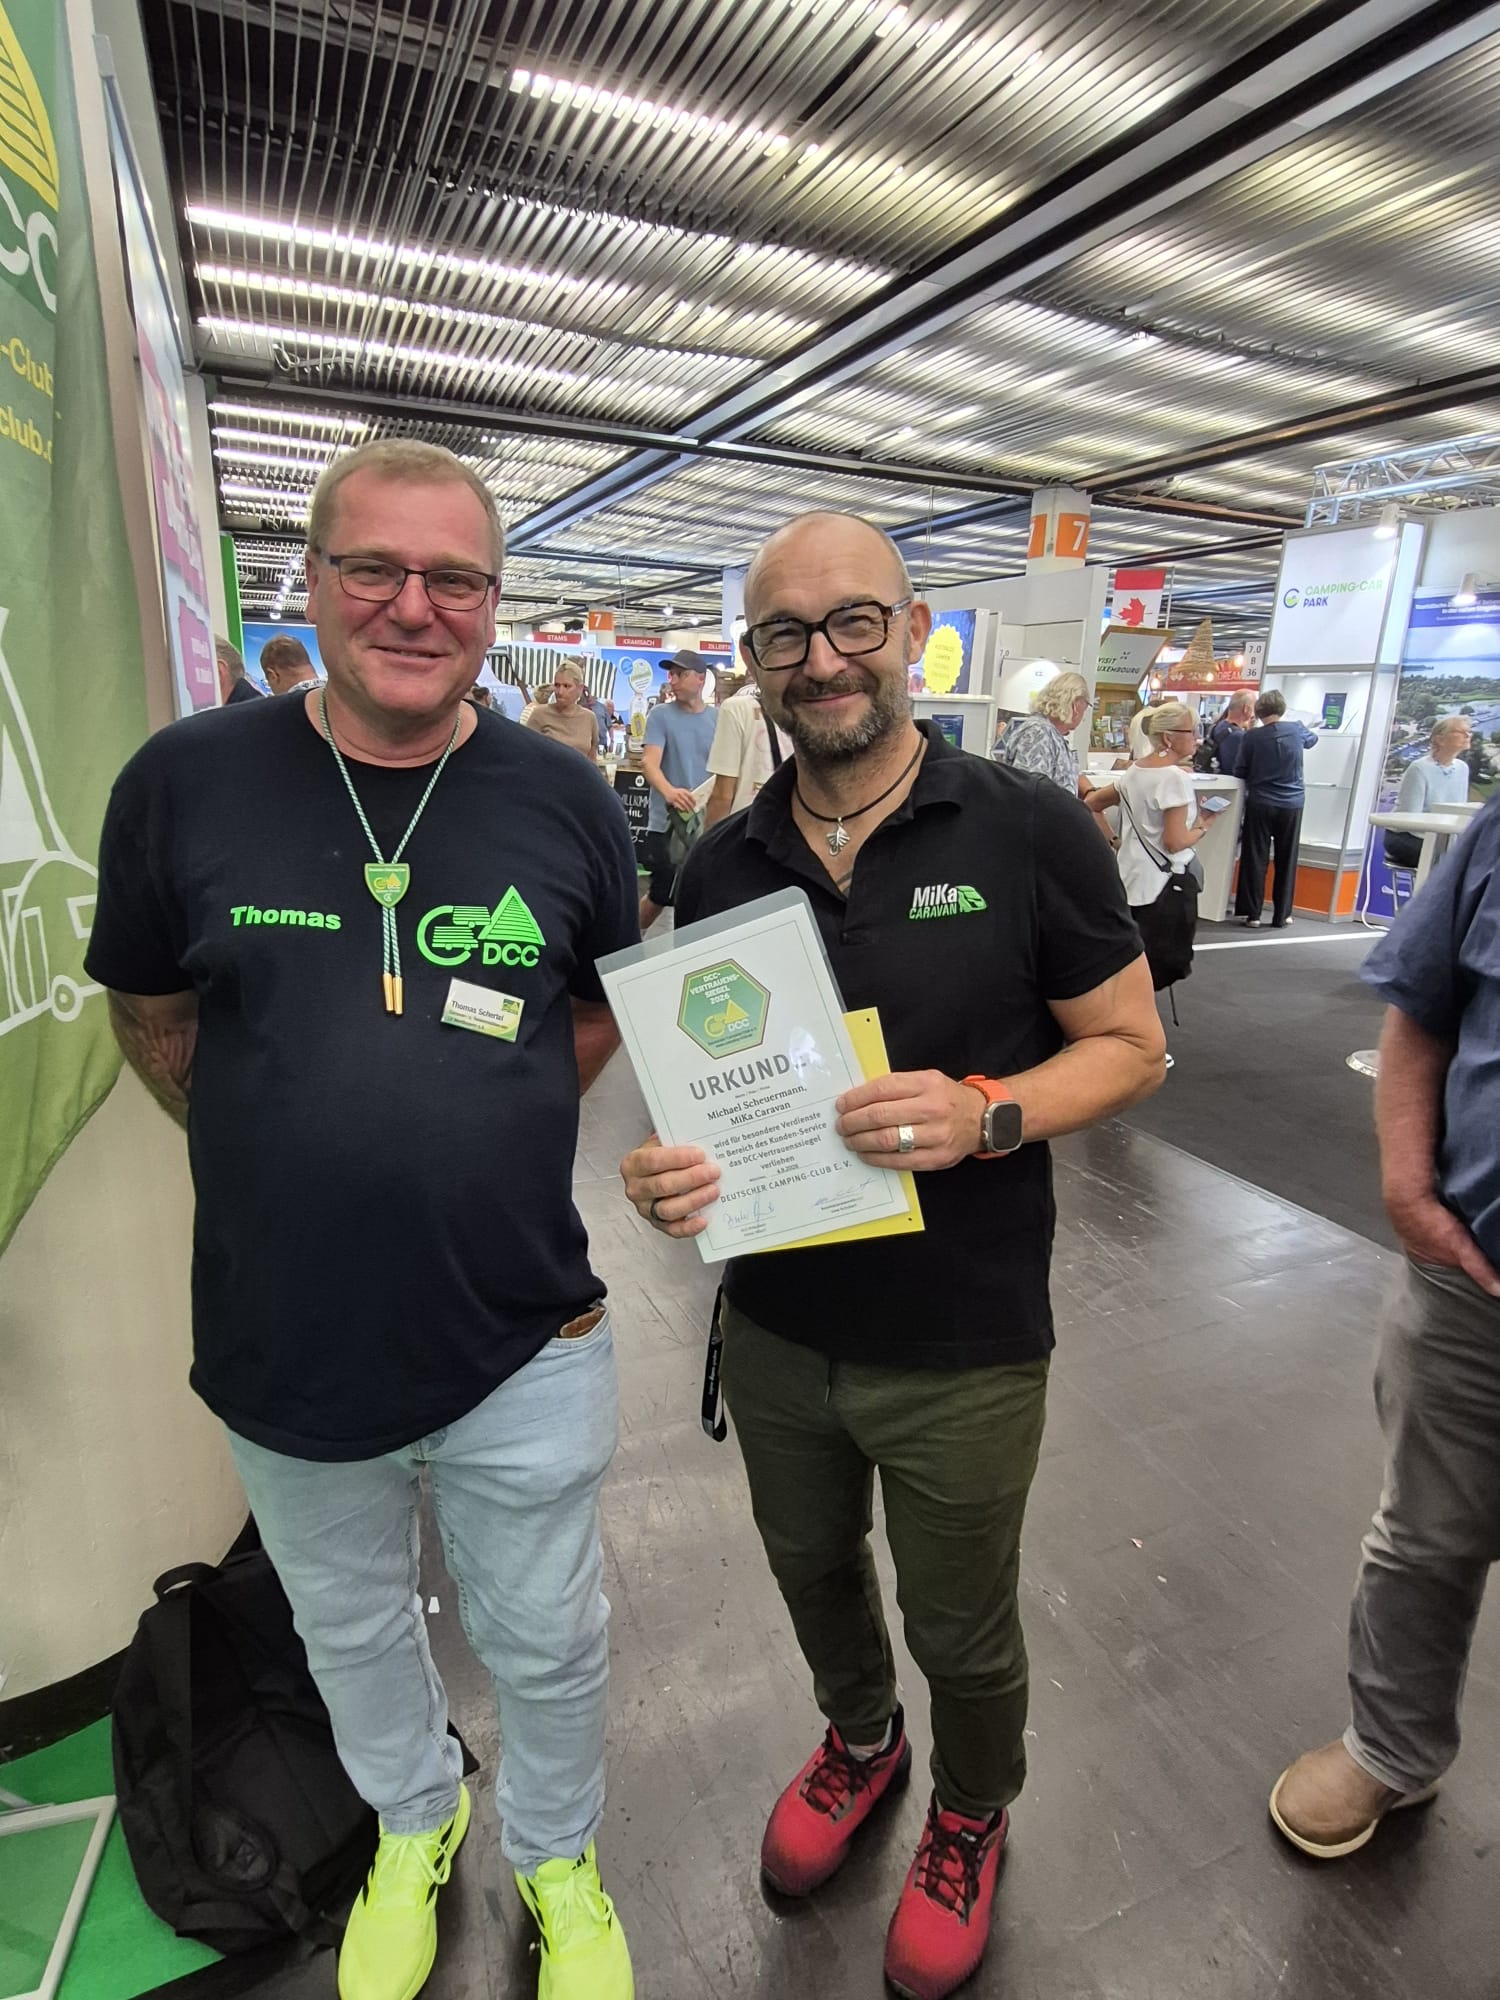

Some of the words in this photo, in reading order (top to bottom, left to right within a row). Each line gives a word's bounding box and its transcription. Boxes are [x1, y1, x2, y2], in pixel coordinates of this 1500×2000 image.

[1072, 520, 1086, 552] 7
[1305, 580, 1383, 596] CAMPING-CAR
[1303, 597, 1329, 608] PARK
[593, 613, 602, 628] 7
[1248, 645, 1262, 654] 7.0
[1098, 656, 1117, 664] VISIT
[1096, 665, 1141, 674] UXEMBOURG
[1247, 669, 1257, 677] 36
[912, 883, 958, 908] MiKa
[230, 905, 342, 930] Thomas
[909, 902, 957, 920] CARAVAN
[481, 942, 541, 967] DCC
[690, 973, 740, 996] VERTRAUENS-
[703, 972, 721, 983] DCC-
[704, 985, 731, 999] SIEGEL
[451, 1000, 477, 1014] Thomas
[727, 1019, 750, 1033] DCC
[689, 1054, 807, 1101] URKUND
[707, 1103, 742, 1121] Michael
[730, 1112, 754, 1126] MiKa
[755, 1101, 792, 1119] Caravan
[713, 1136, 730, 1149] wird
[730, 1134, 741, 1146] für
[741, 1124, 781, 1141] besondere
[780, 1111, 822, 1129] Verdienste
[726, 1143, 754, 1157] Bereich
[755, 1139, 769, 1150] des
[769, 1121, 828, 1145] Kunden-Service
[728, 1159, 743, 1168] das
[742, 1135, 822, 1164] DCC-Vertrauenssiegel
[760, 1155, 796, 1170] verliehen
[720, 1182, 768, 1204] DEUTSCHER
[768, 1165, 832, 1190] CAMPING-CLUB
